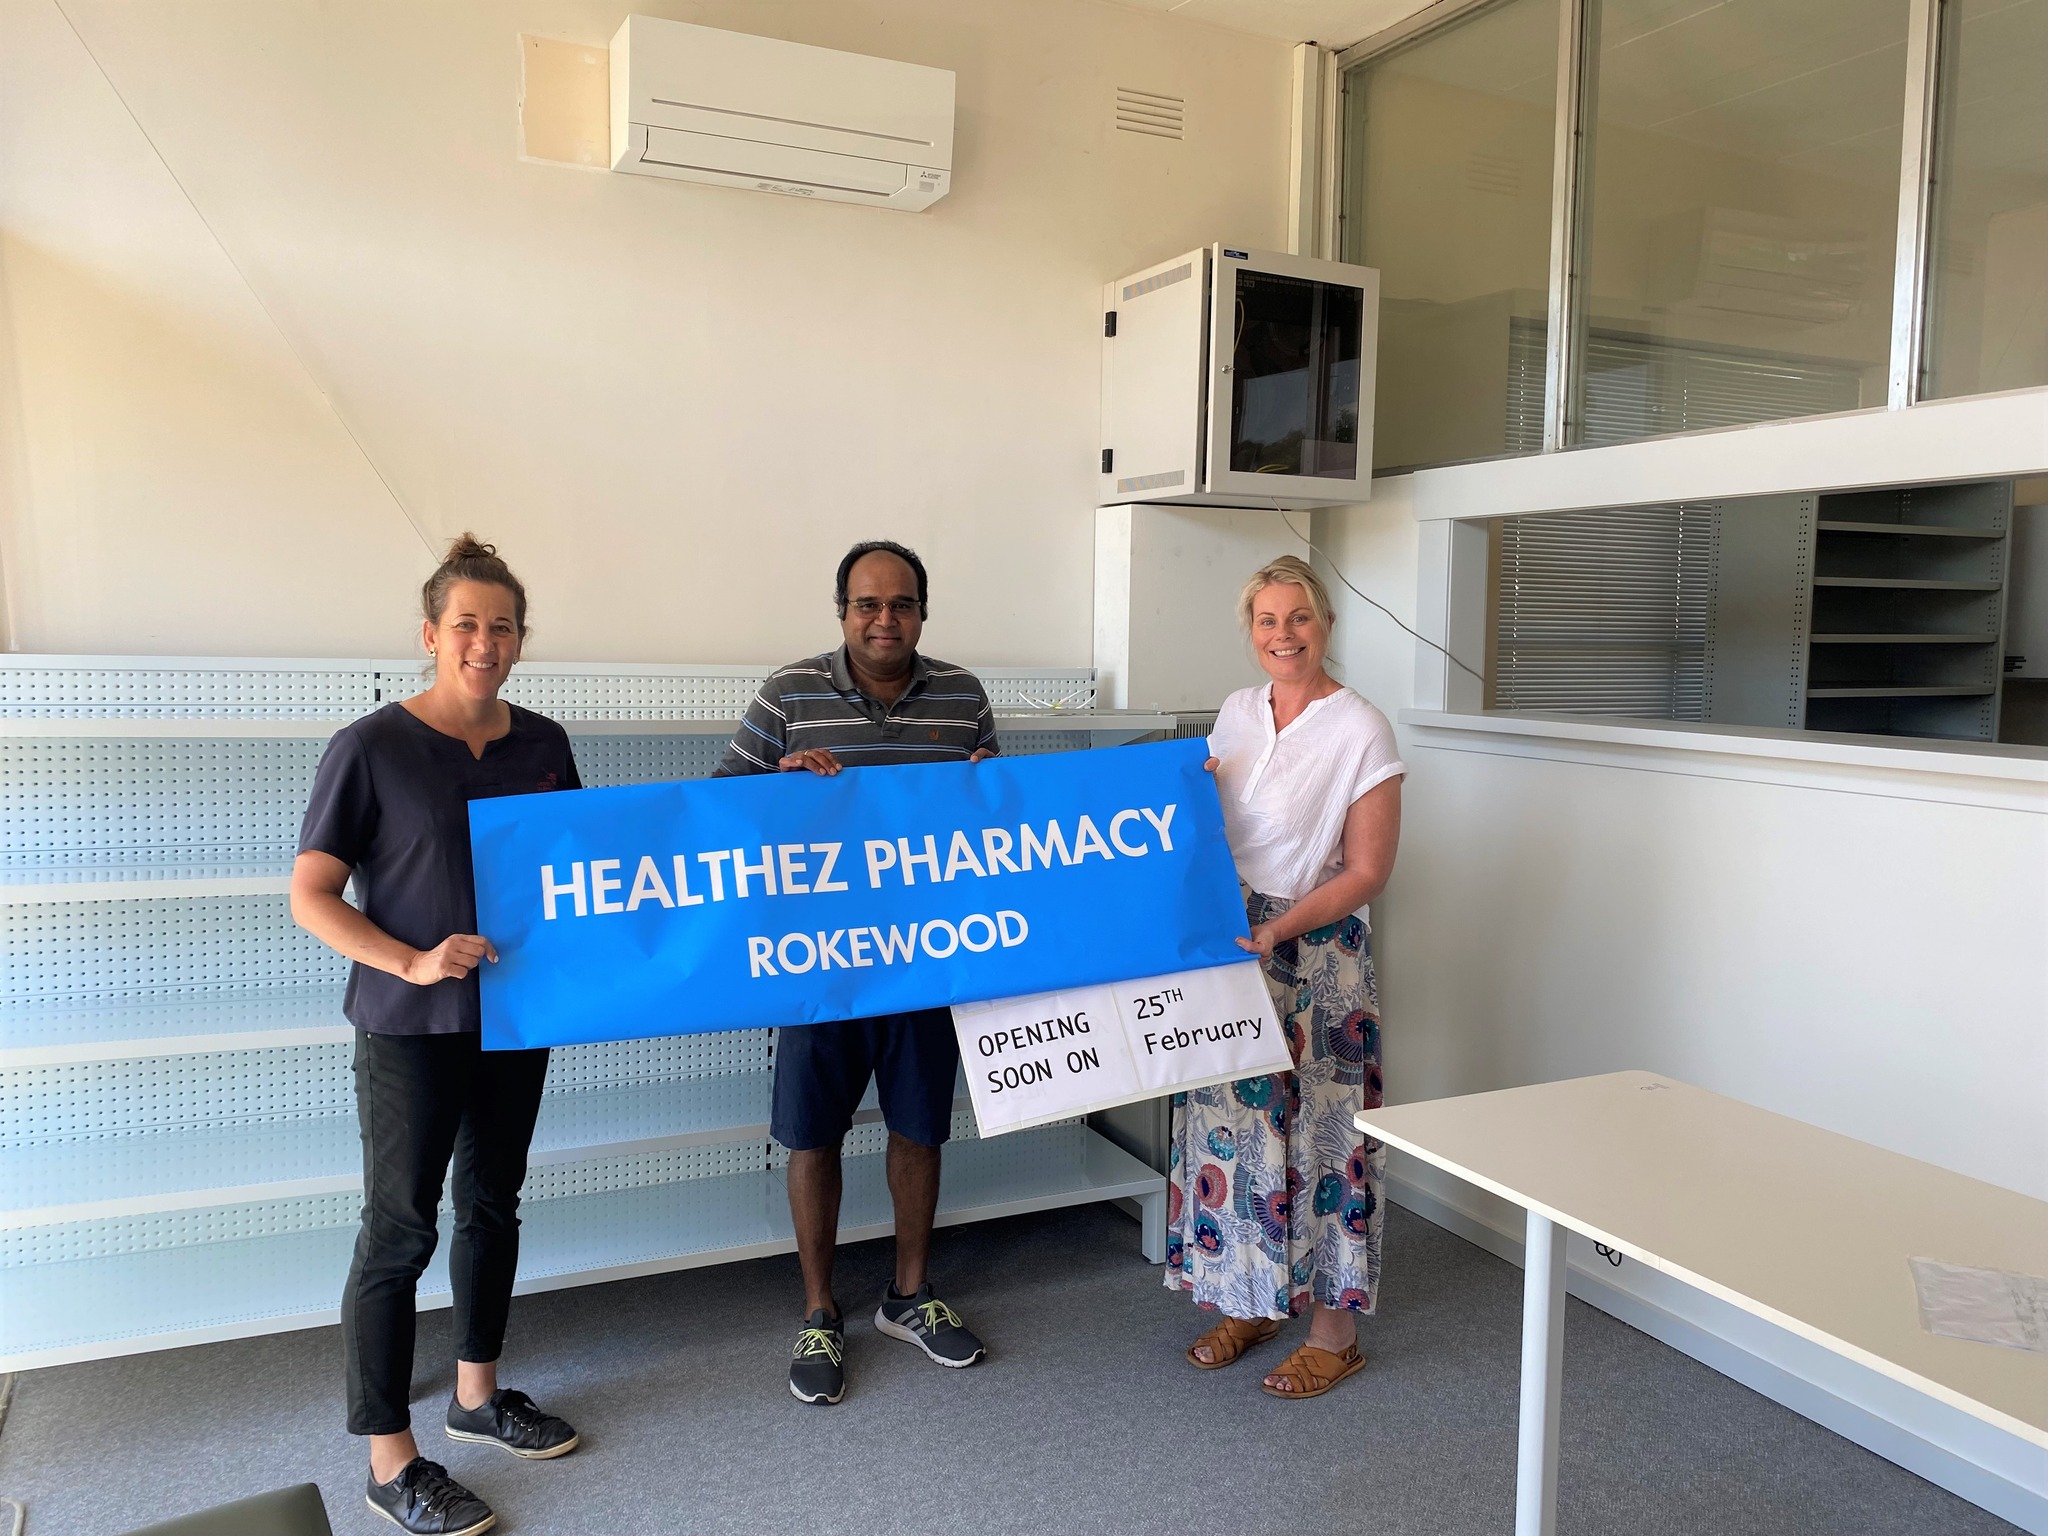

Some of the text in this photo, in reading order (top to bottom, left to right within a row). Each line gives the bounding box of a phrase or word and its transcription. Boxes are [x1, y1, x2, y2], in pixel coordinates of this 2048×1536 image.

[540, 804, 1178, 921] HEALTHEZ PHARMACY
[747, 910, 1029, 978] ROKEWOOD
[978, 1011, 1091, 1057] OPENING
[1143, 1017, 1262, 1055] February
[987, 1047, 1100, 1094] SOON ON
